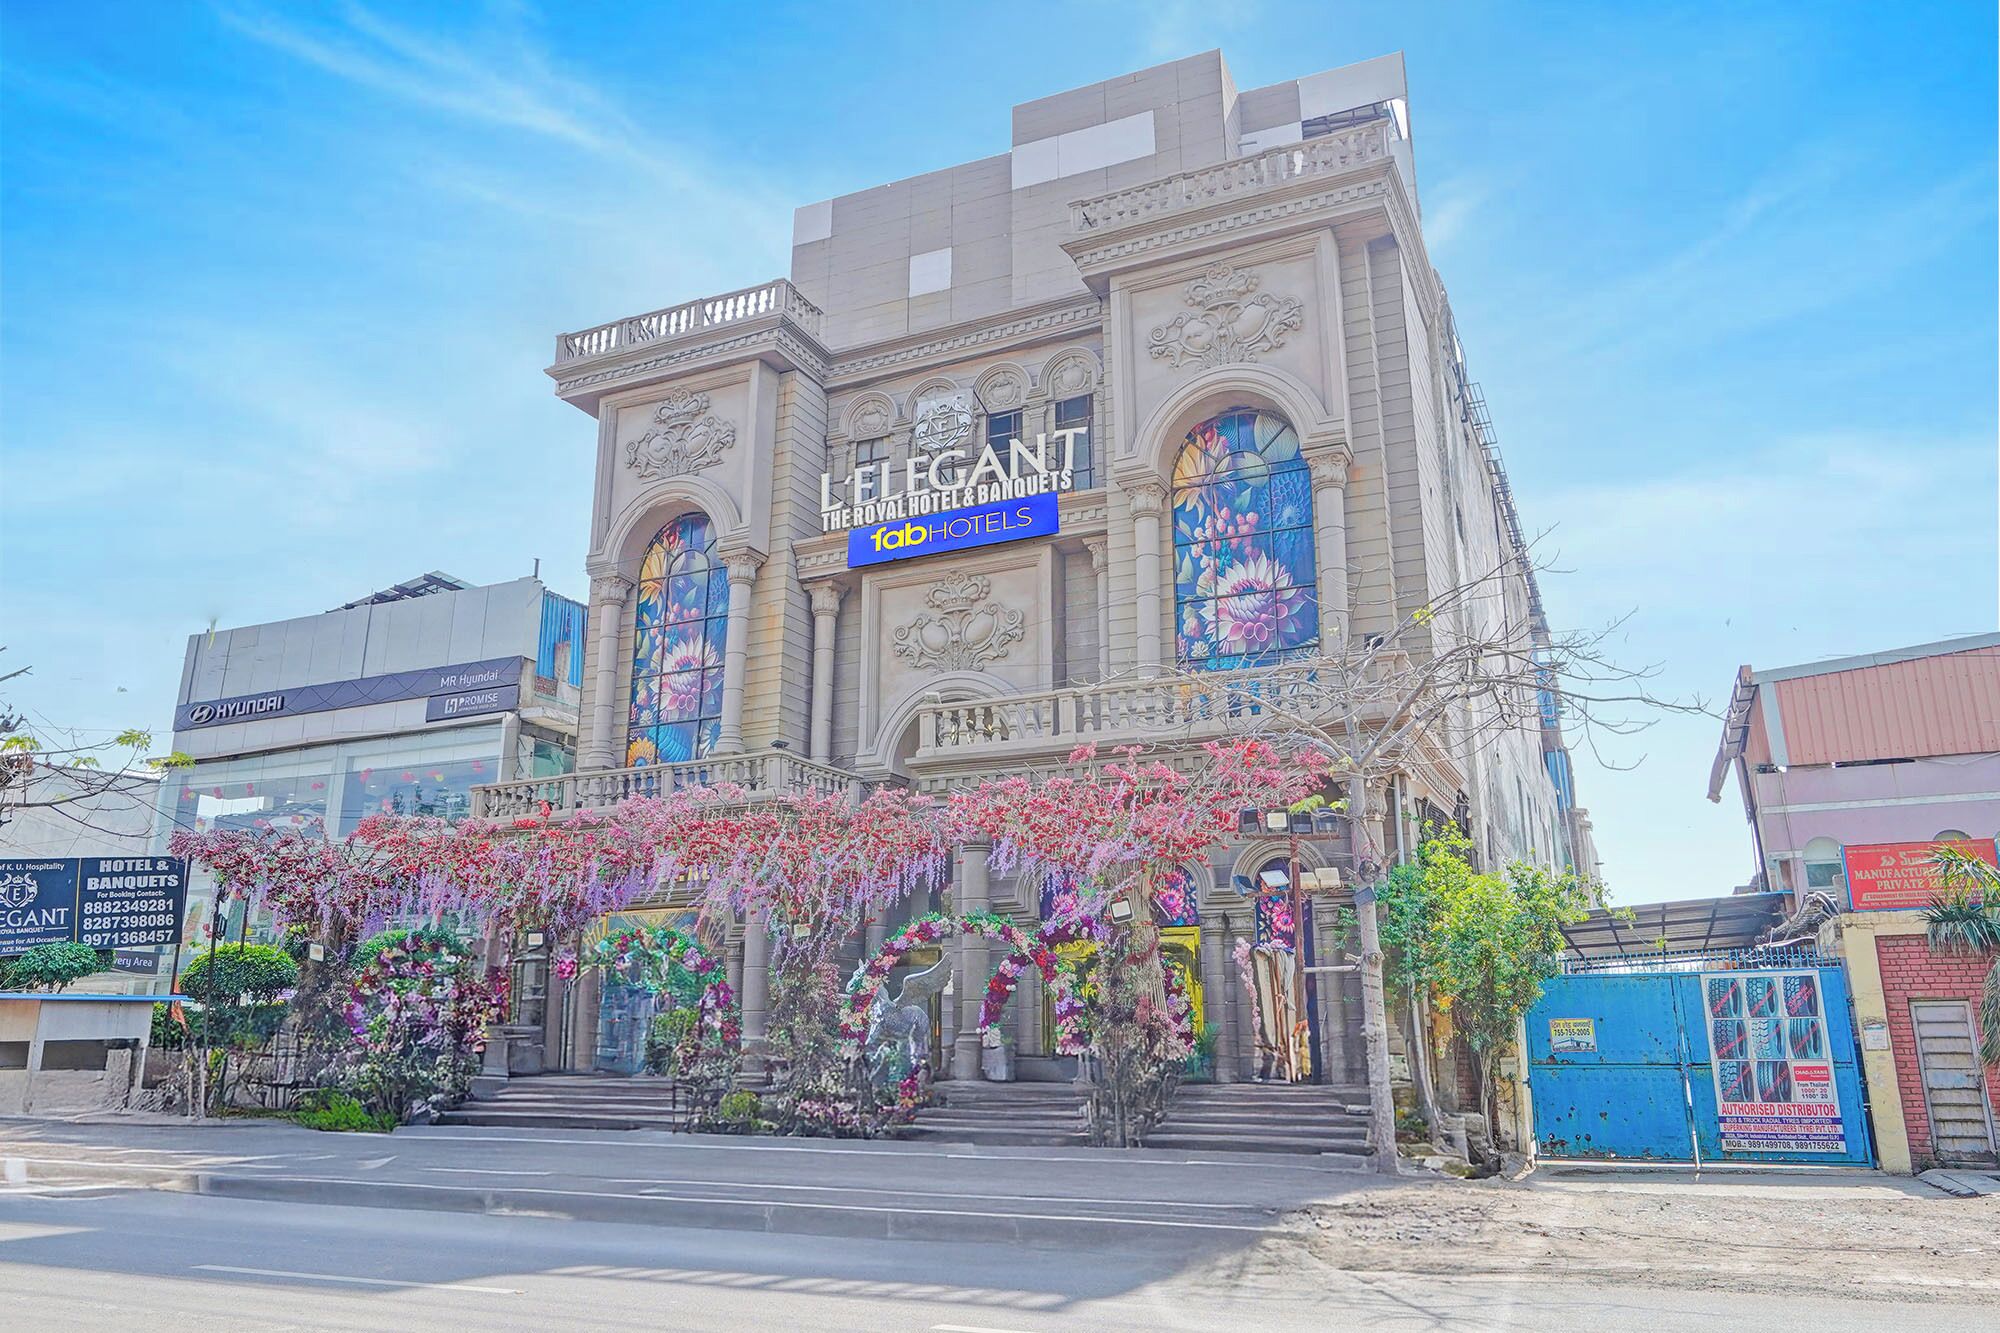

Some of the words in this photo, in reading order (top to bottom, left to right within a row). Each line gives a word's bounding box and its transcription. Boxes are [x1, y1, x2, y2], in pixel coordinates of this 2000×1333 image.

[821, 508, 851, 532] THE
[853, 499, 907, 527] ROYAL
[909, 490, 961, 517] HOTEL
[963, 487, 975, 506] &
[977, 469, 1073, 505] BANQUETS
[440, 675, 457, 688] MR
[459, 669, 498, 687] Hyundai
[216, 695, 284, 718] HYUNDAI
[458, 692, 498, 707] PROMISE
[6, 863, 14, 871] K.
[16, 863, 24, 871] U.
[26, 862, 65, 871] Hospitality
[100, 859, 153, 873] HOTEL
[156, 860, 169, 871] &
[87, 874, 179, 890] BANQUETS
[1876, 877, 1925, 891] PRIVATE
[109, 891, 135, 899] Booking
[83, 898, 174, 915] 8882349281
[83, 914, 174, 930] 8287398086
[0, 927, 15, 935] OYAL
[16, 926, 44, 934] BANQUET
[82, 929, 174, 946] 9971368457
[133, 956, 153, 967] Area
[1721, 1103, 1776, 1116] AUTHORISED
[1777, 1103, 1836, 1117] DISTRIBUTOR
[1723, 1124, 1752, 1132] SUPERKING
[1752, 1124, 1796, 1132] MANUFACTURERS
[1828, 1125, 1840, 1133] LTD.
[1748, 1141, 1794, 1150] 9891499708,
[1794, 1142, 1840, 1150] 9891755622
